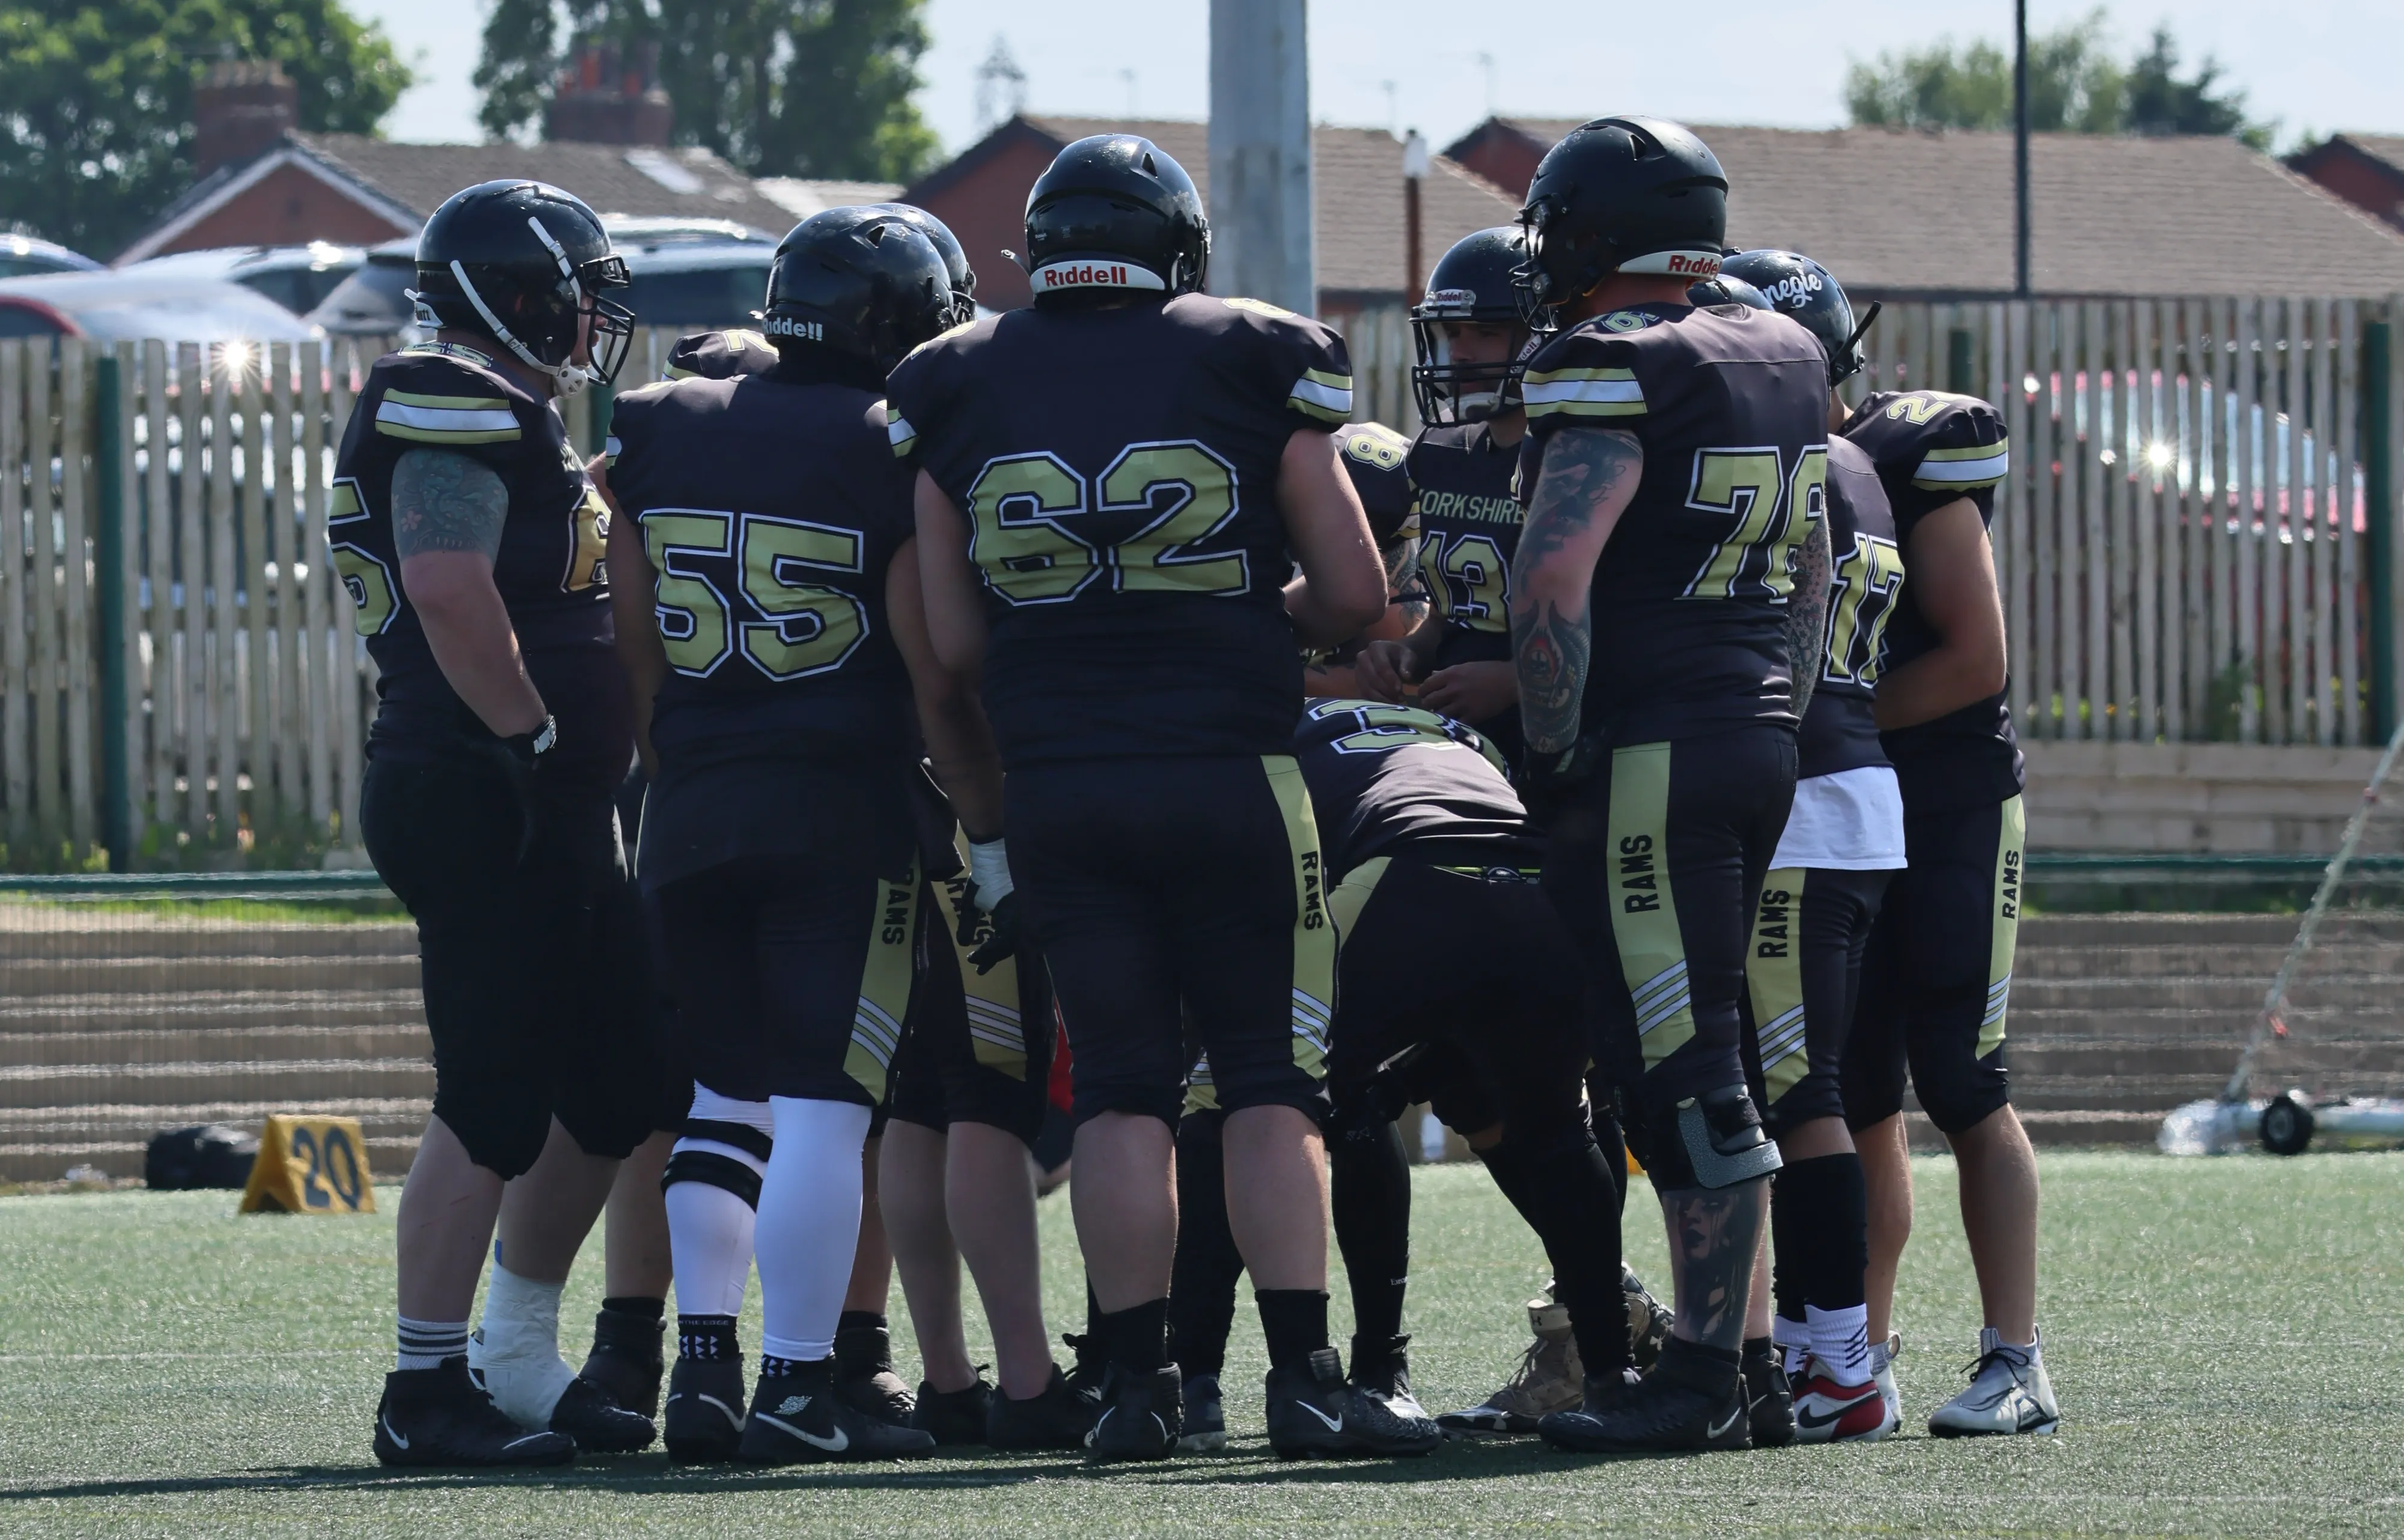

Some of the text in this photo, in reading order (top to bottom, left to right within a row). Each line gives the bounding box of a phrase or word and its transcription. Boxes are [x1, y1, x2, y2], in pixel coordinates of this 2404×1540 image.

[1044, 266, 1127, 287] Riddell
[1437, 292, 1461, 302] Riddel
[1668, 255, 1722, 275] Riddel
[1759, 268, 1822, 309] negie
[761, 317, 823, 341] Riddell
[966, 439, 1251, 607] 62
[638, 508, 870, 682] 55
[1416, 531, 1513, 633] 13
[1822, 532, 1905, 689] 17
[1301, 851, 1323, 931] RAMS
[1621, 834, 1660, 914] RAMS
[2001, 850, 2019, 919] RAMS
[1757, 888, 1790, 958] RAMS
[291, 1125, 361, 1210] 20
